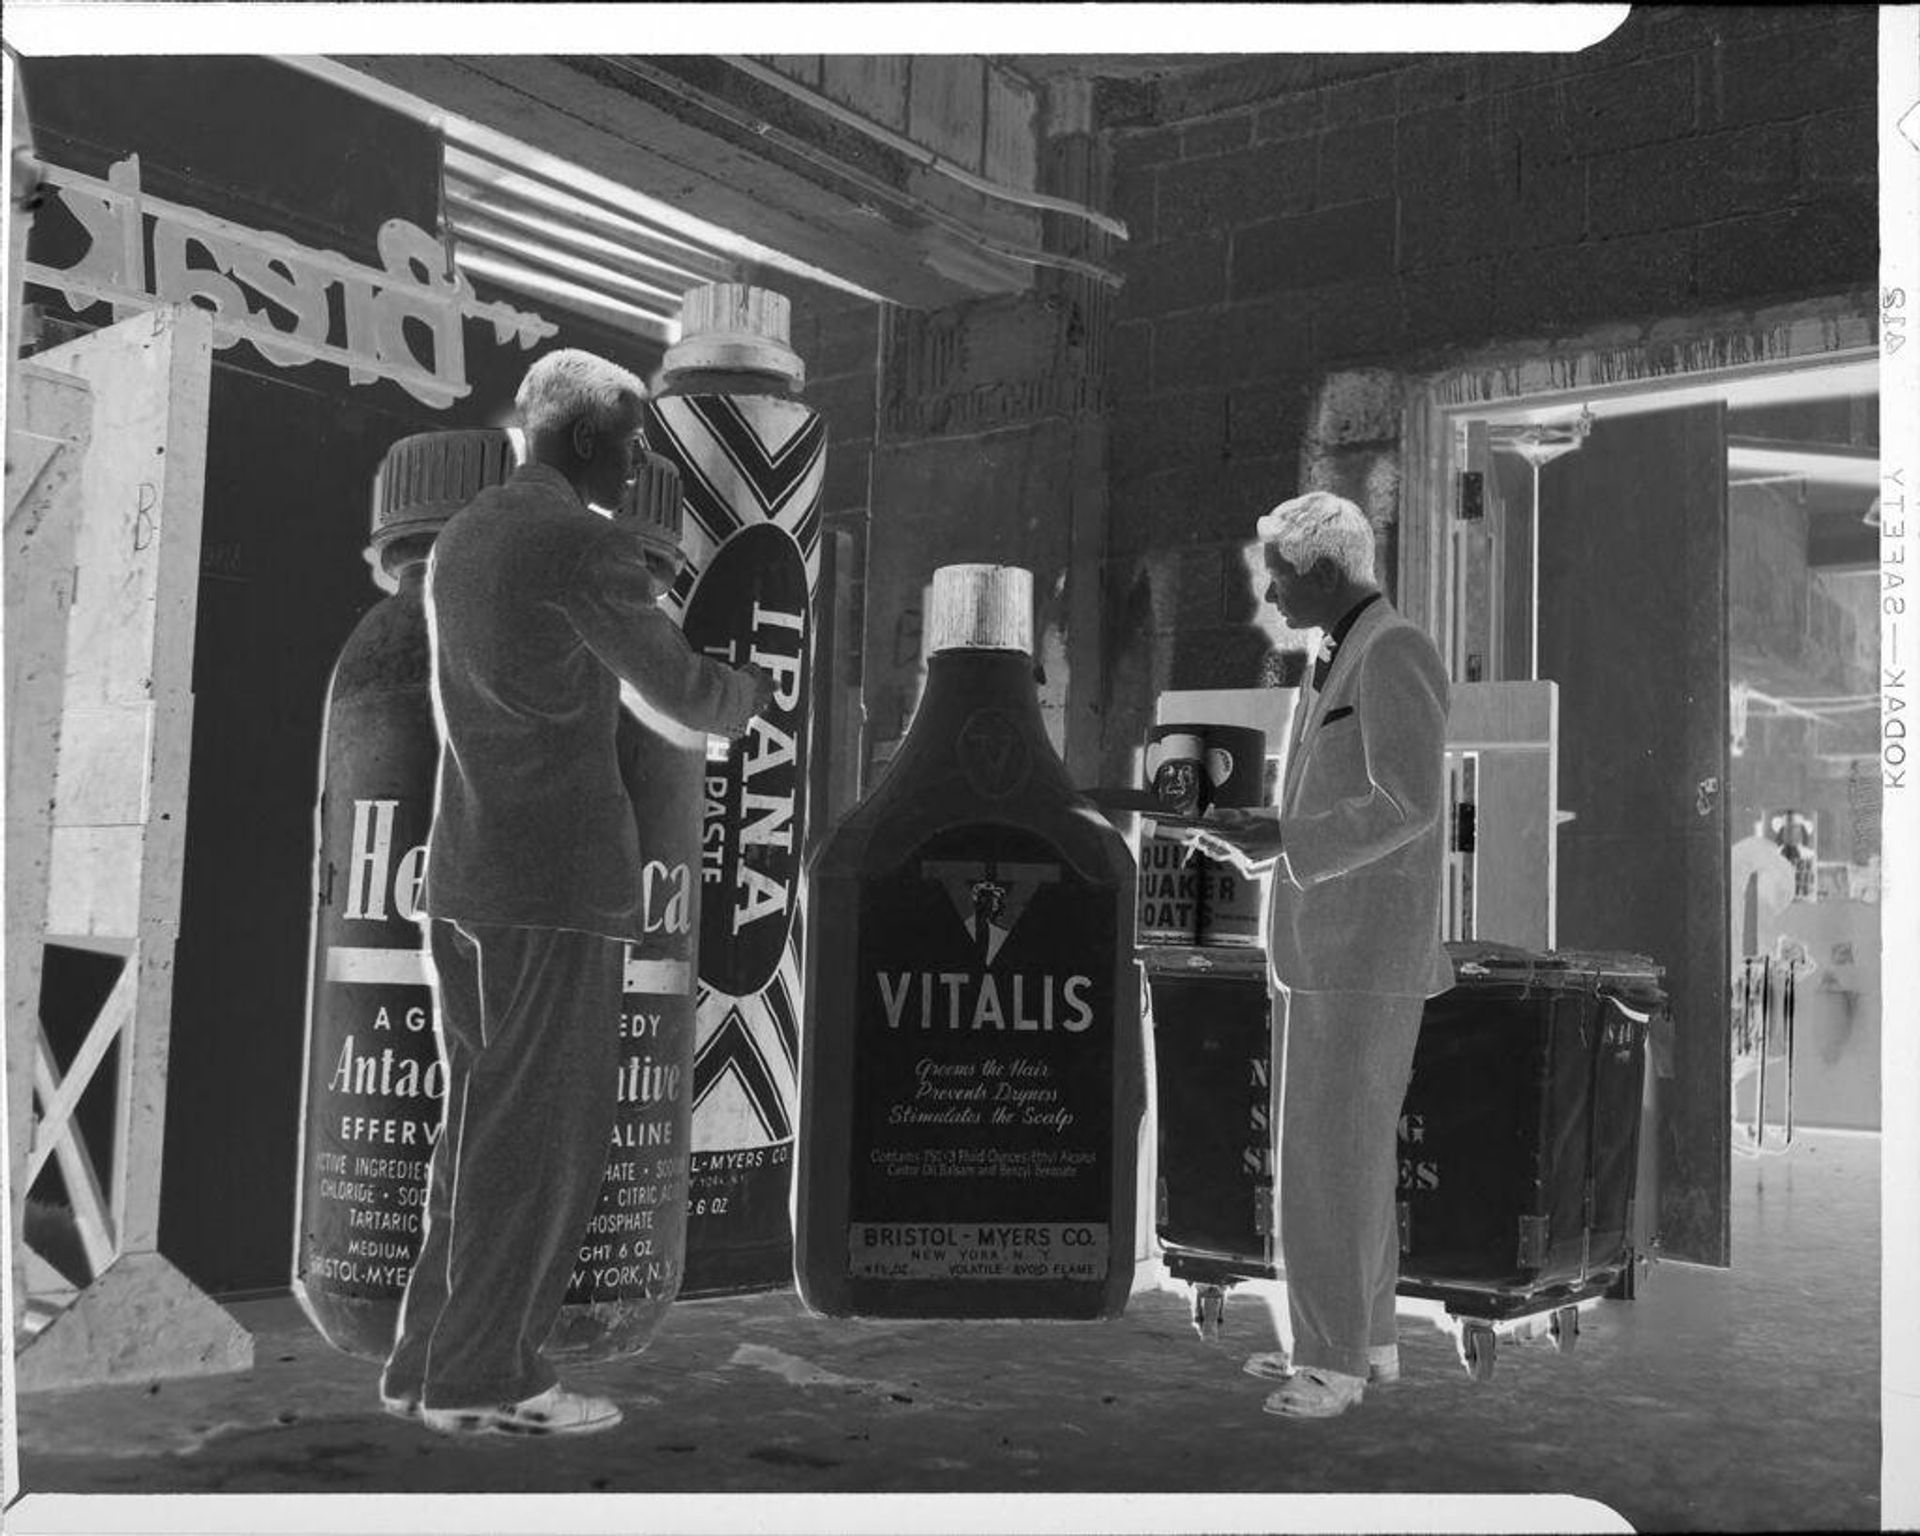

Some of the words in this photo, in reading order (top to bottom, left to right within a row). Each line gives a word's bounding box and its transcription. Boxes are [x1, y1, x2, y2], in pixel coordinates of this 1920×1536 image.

[733, 601, 806, 936] IPANA
[702, 777, 728, 883] PASTE
[343, 800, 430, 922] He
[642, 859, 692, 935] ca
[876, 971, 1095, 1033] VITALIS
[373, 1006, 391, 1030] A
[620, 1013, 661, 1037] EDY
[328, 1034, 450, 1099] Antac
[617, 1056, 681, 1102] tive
[915, 1057, 975, 1081] Grooms
[982, 1058, 1005, 1077] the
[1009, 1058, 1050, 1078] Hair
[915, 1082, 987, 1101] Prevents
[993, 1082, 1058, 1106] Dryness
[341, 1115, 444, 1146] EFFERV
[610, 1120, 673, 1148] ALINE
[888, 1104, 981, 1125] Stimulates
[991, 1106, 1014, 1125] the
[1023, 1106, 1074, 1133] Scalp
[354, 1156, 430, 1181] INGREDIE
[602, 1161, 636, 1183] HATE
[691, 1150, 766, 1172] L-MYERS
[320, 1178, 376, 1204] CHLORIDE
[397, 1186, 428, 1207] SOD
[618, 1186, 658, 1208] CITRIC
[349, 1207, 419, 1234] TARTARIC
[586, 1210, 655, 1235] HOSPHATE
[347, 1239, 411, 1260] MEDIUM
[578, 1244, 612, 1263] GHT
[618, 1242, 628, 1259] 6
[911, 1249, 946, 1262] NEW
